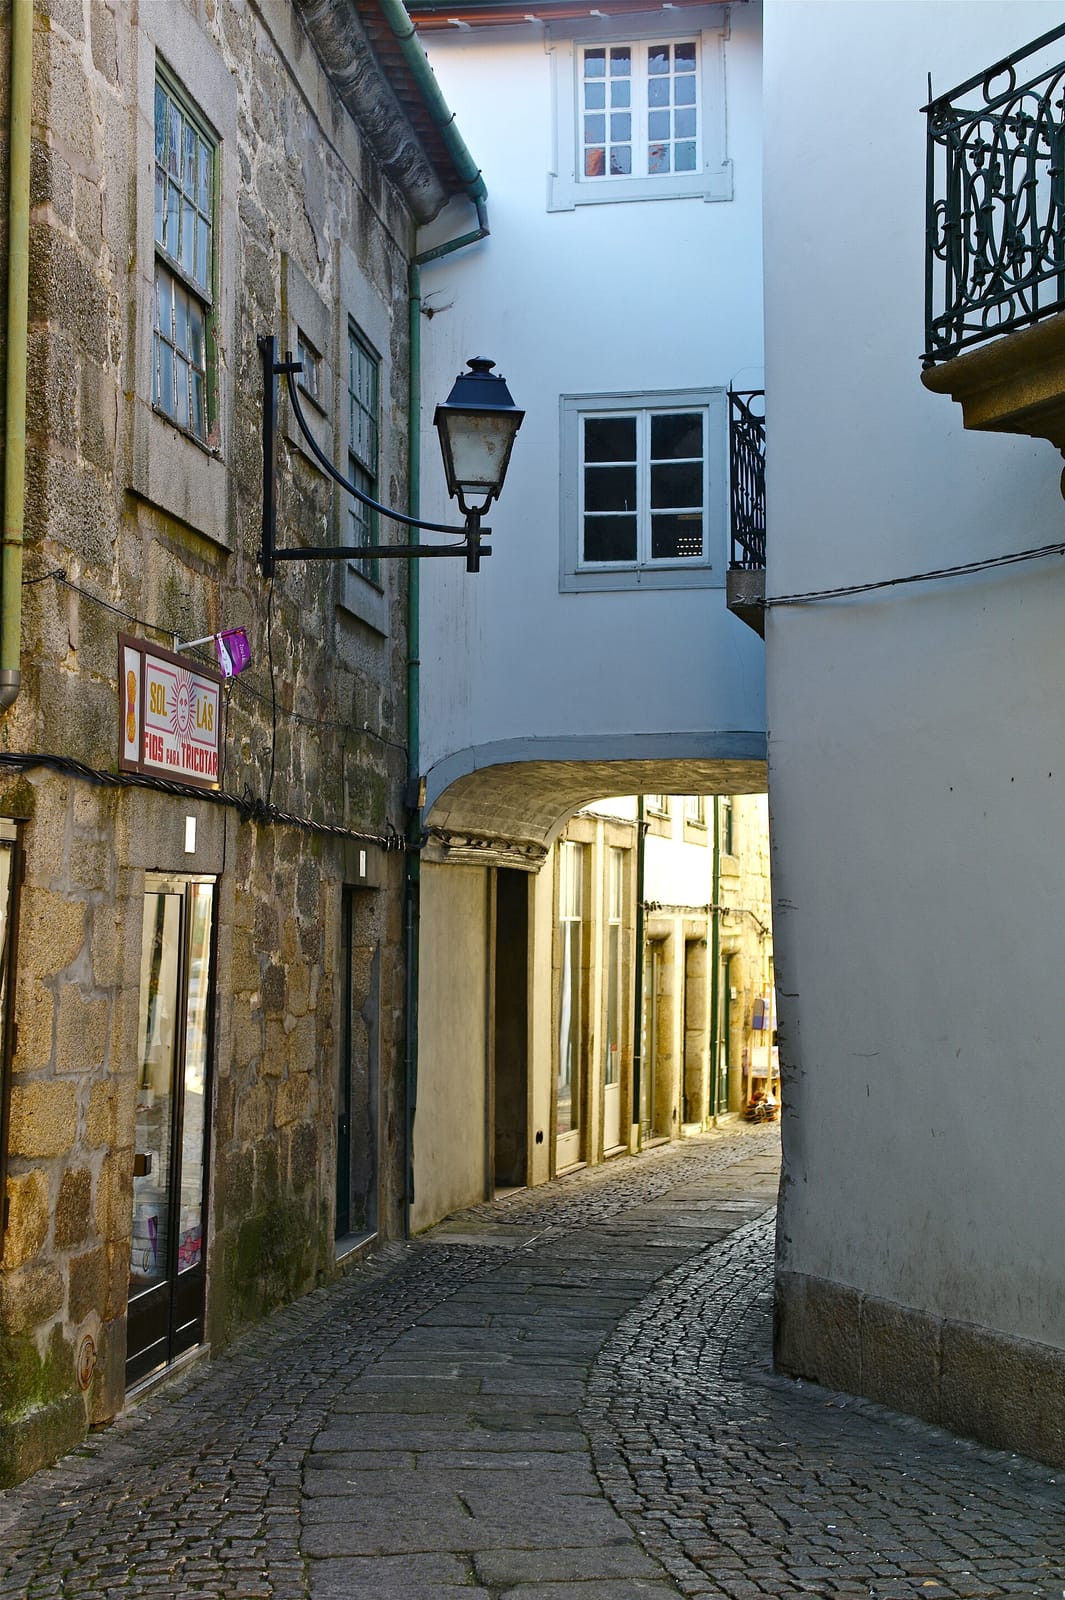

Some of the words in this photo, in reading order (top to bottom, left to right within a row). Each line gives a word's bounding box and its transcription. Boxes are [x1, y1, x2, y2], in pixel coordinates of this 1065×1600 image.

[149, 681, 168, 717] SOL
[144, 731, 164, 763] FIOS
[165, 748, 180, 767] PARA
[181, 743, 219, 777] TRICOTAR
